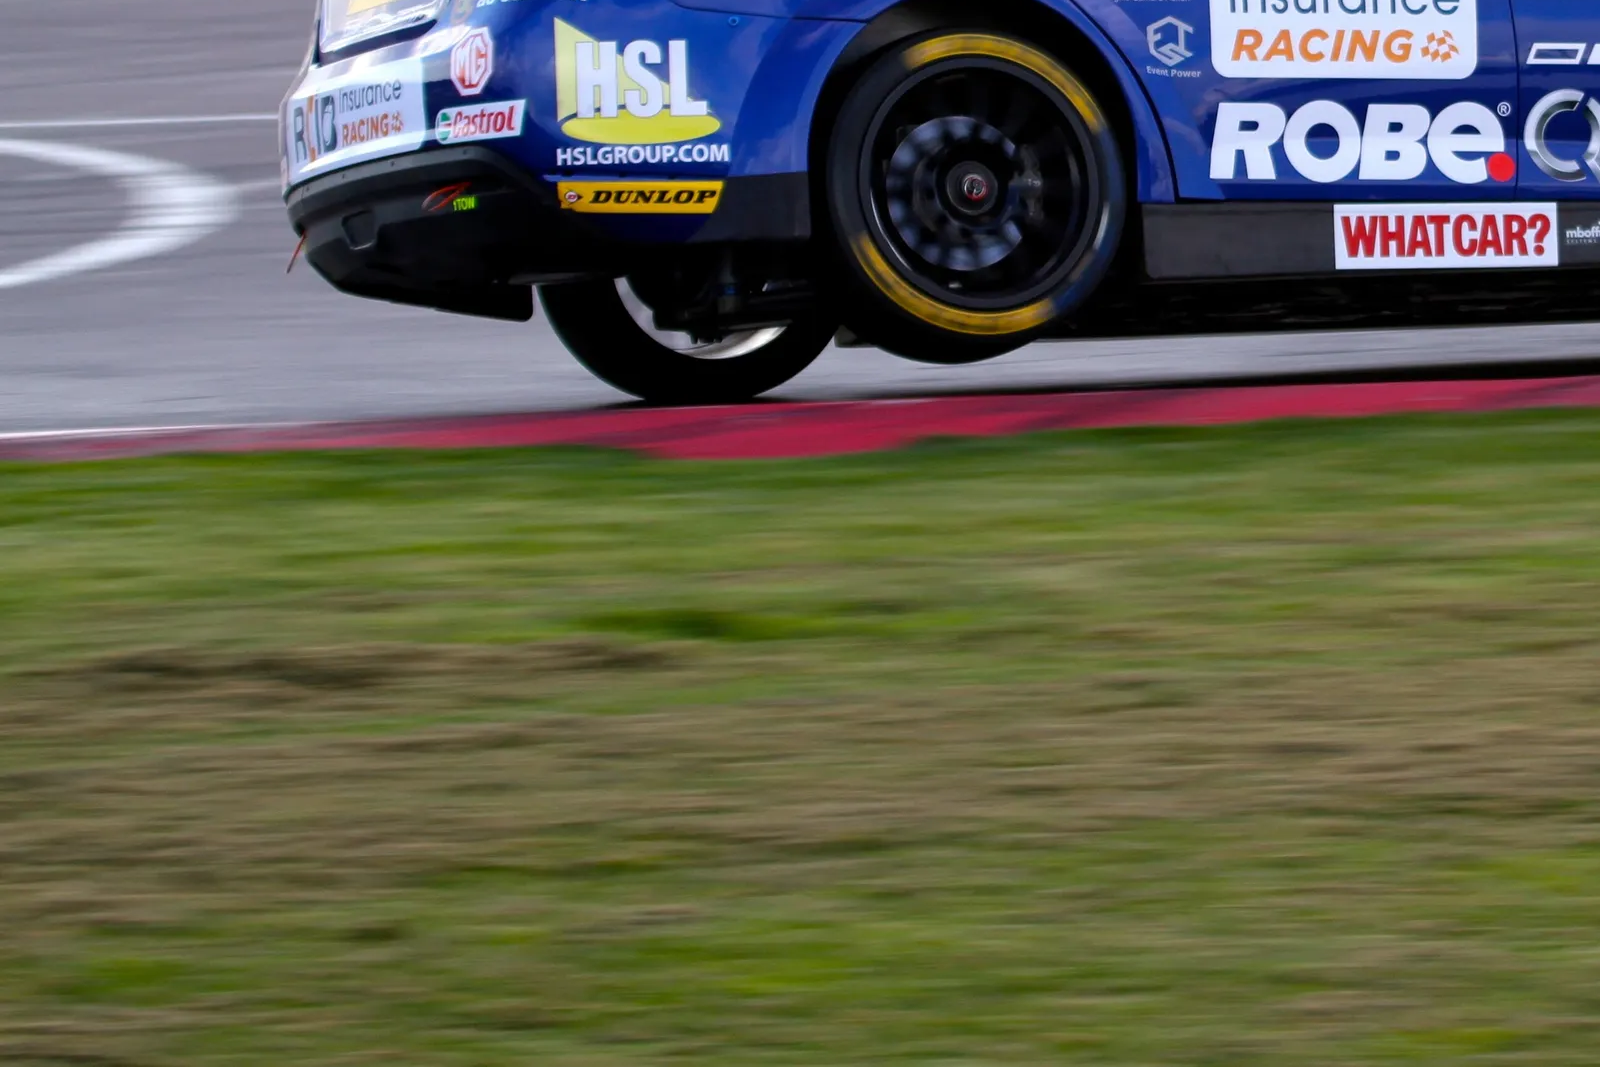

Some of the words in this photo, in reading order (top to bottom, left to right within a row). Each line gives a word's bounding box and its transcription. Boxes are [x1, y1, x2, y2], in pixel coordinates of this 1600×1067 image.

[456, 34, 490, 88] MG
[1230, 29, 1414, 64] RACING
[575, 39, 708, 119] HSL
[1146, 66, 1169, 77] Event
[1170, 69, 1202, 78] Power
[339, 79, 402, 114] Insurance
[342, 113, 389, 148] RACING
[451, 105, 516, 138] Castrol
[556, 144, 729, 166] HSLGROUP.COM
[589, 189, 717, 204] DUNLOP
